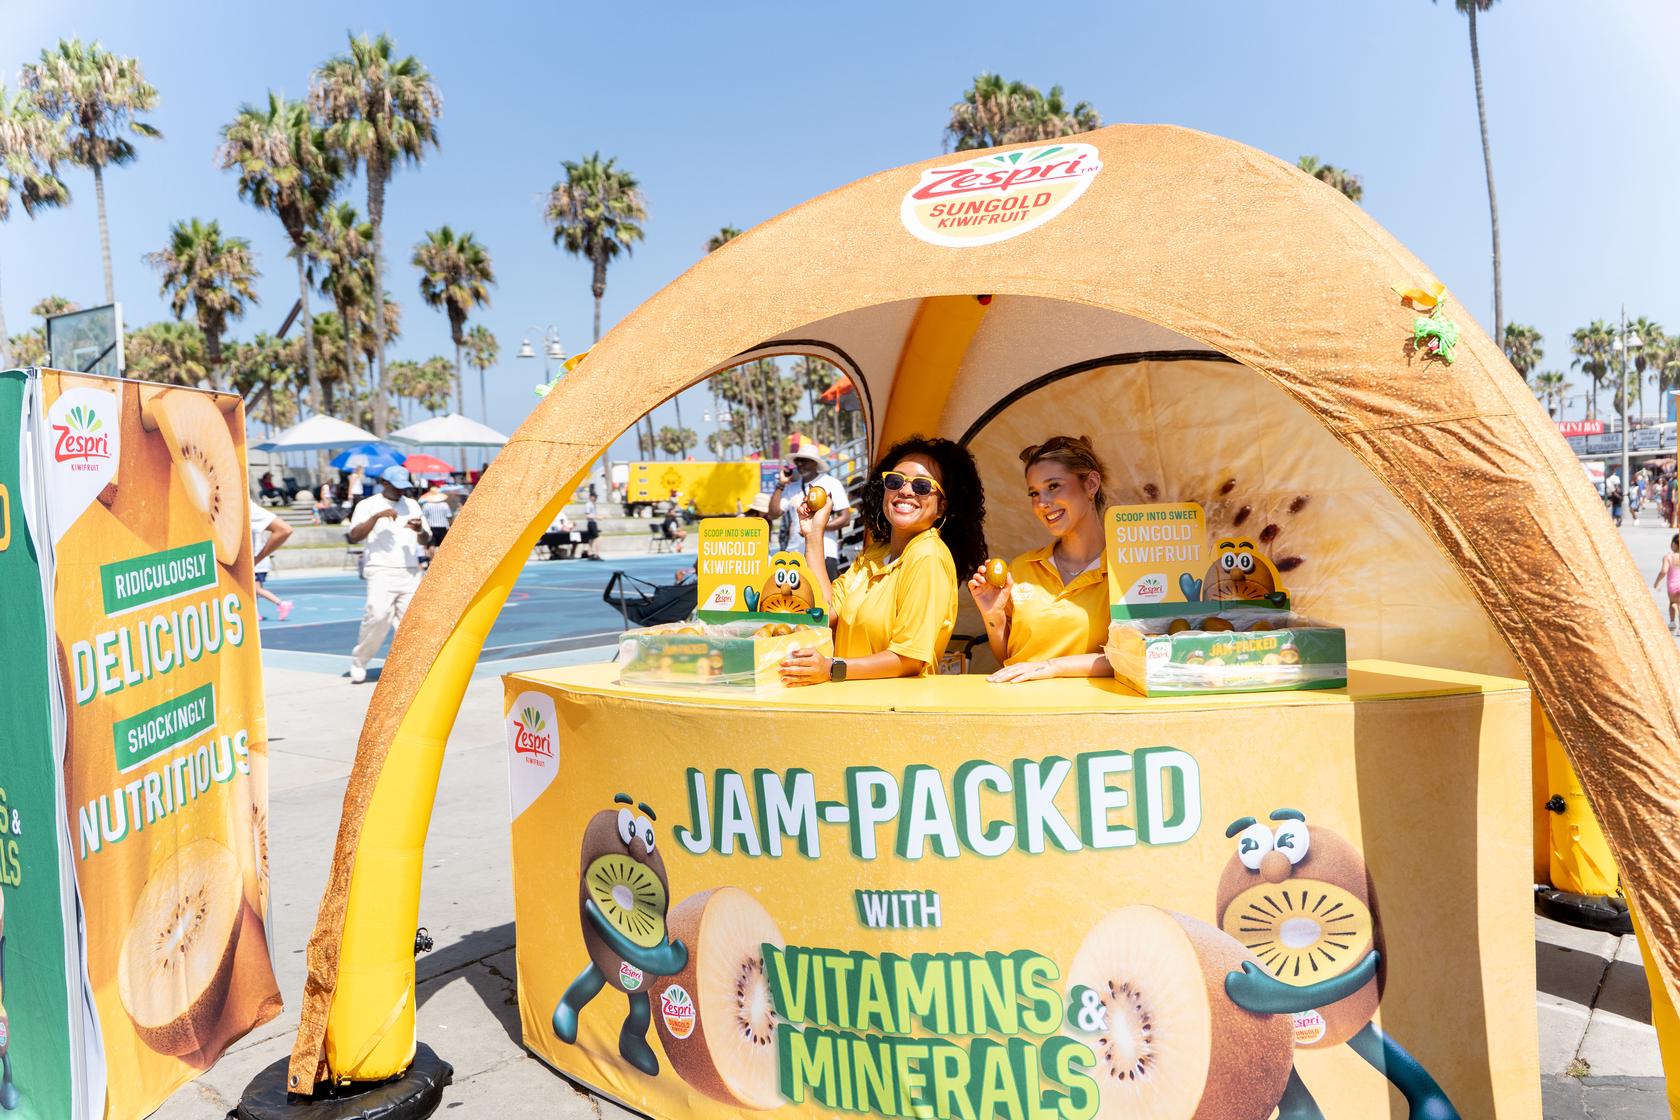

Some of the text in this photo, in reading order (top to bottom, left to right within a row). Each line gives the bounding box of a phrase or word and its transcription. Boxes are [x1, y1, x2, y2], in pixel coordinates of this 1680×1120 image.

[912, 154, 1088, 200] Zespri
[929, 192, 1052, 218] SUNGOLD
[937, 210, 1031, 229] KIWIFRUIT
[52, 424, 111, 463] Zespri
[1116, 510, 1198, 522] SCOOP INTO SWEET
[704, 528, 761, 537] SCOOP INTO SWEET
[704, 541, 756, 556] SUNGOLD
[1117, 524, 1192, 543] SUNGOLD
[704, 559, 761, 575] KIWIFRUIT
[1118, 544, 1200, 564] KIWIFRUIT
[115, 553, 207, 599] RIDICULOUSLY
[71, 593, 245, 707] DELICIOUS
[128, 696, 206, 754] SHOCKINGLY
[513, 720, 554, 757] Zespri
[79, 729, 250, 860] NUTRITIOUS
[674, 746, 1202, 860] JAM-PACKED
[12, 808, 22, 835] &
[855, 889, 943, 929] WITH
[762, 943, 1107, 1035] VITAMINS &
[662, 996, 693, 1018] Zespri
[1294, 1016, 1319, 1028] spri
[778, 1024, 1101, 1120] MINERALS
